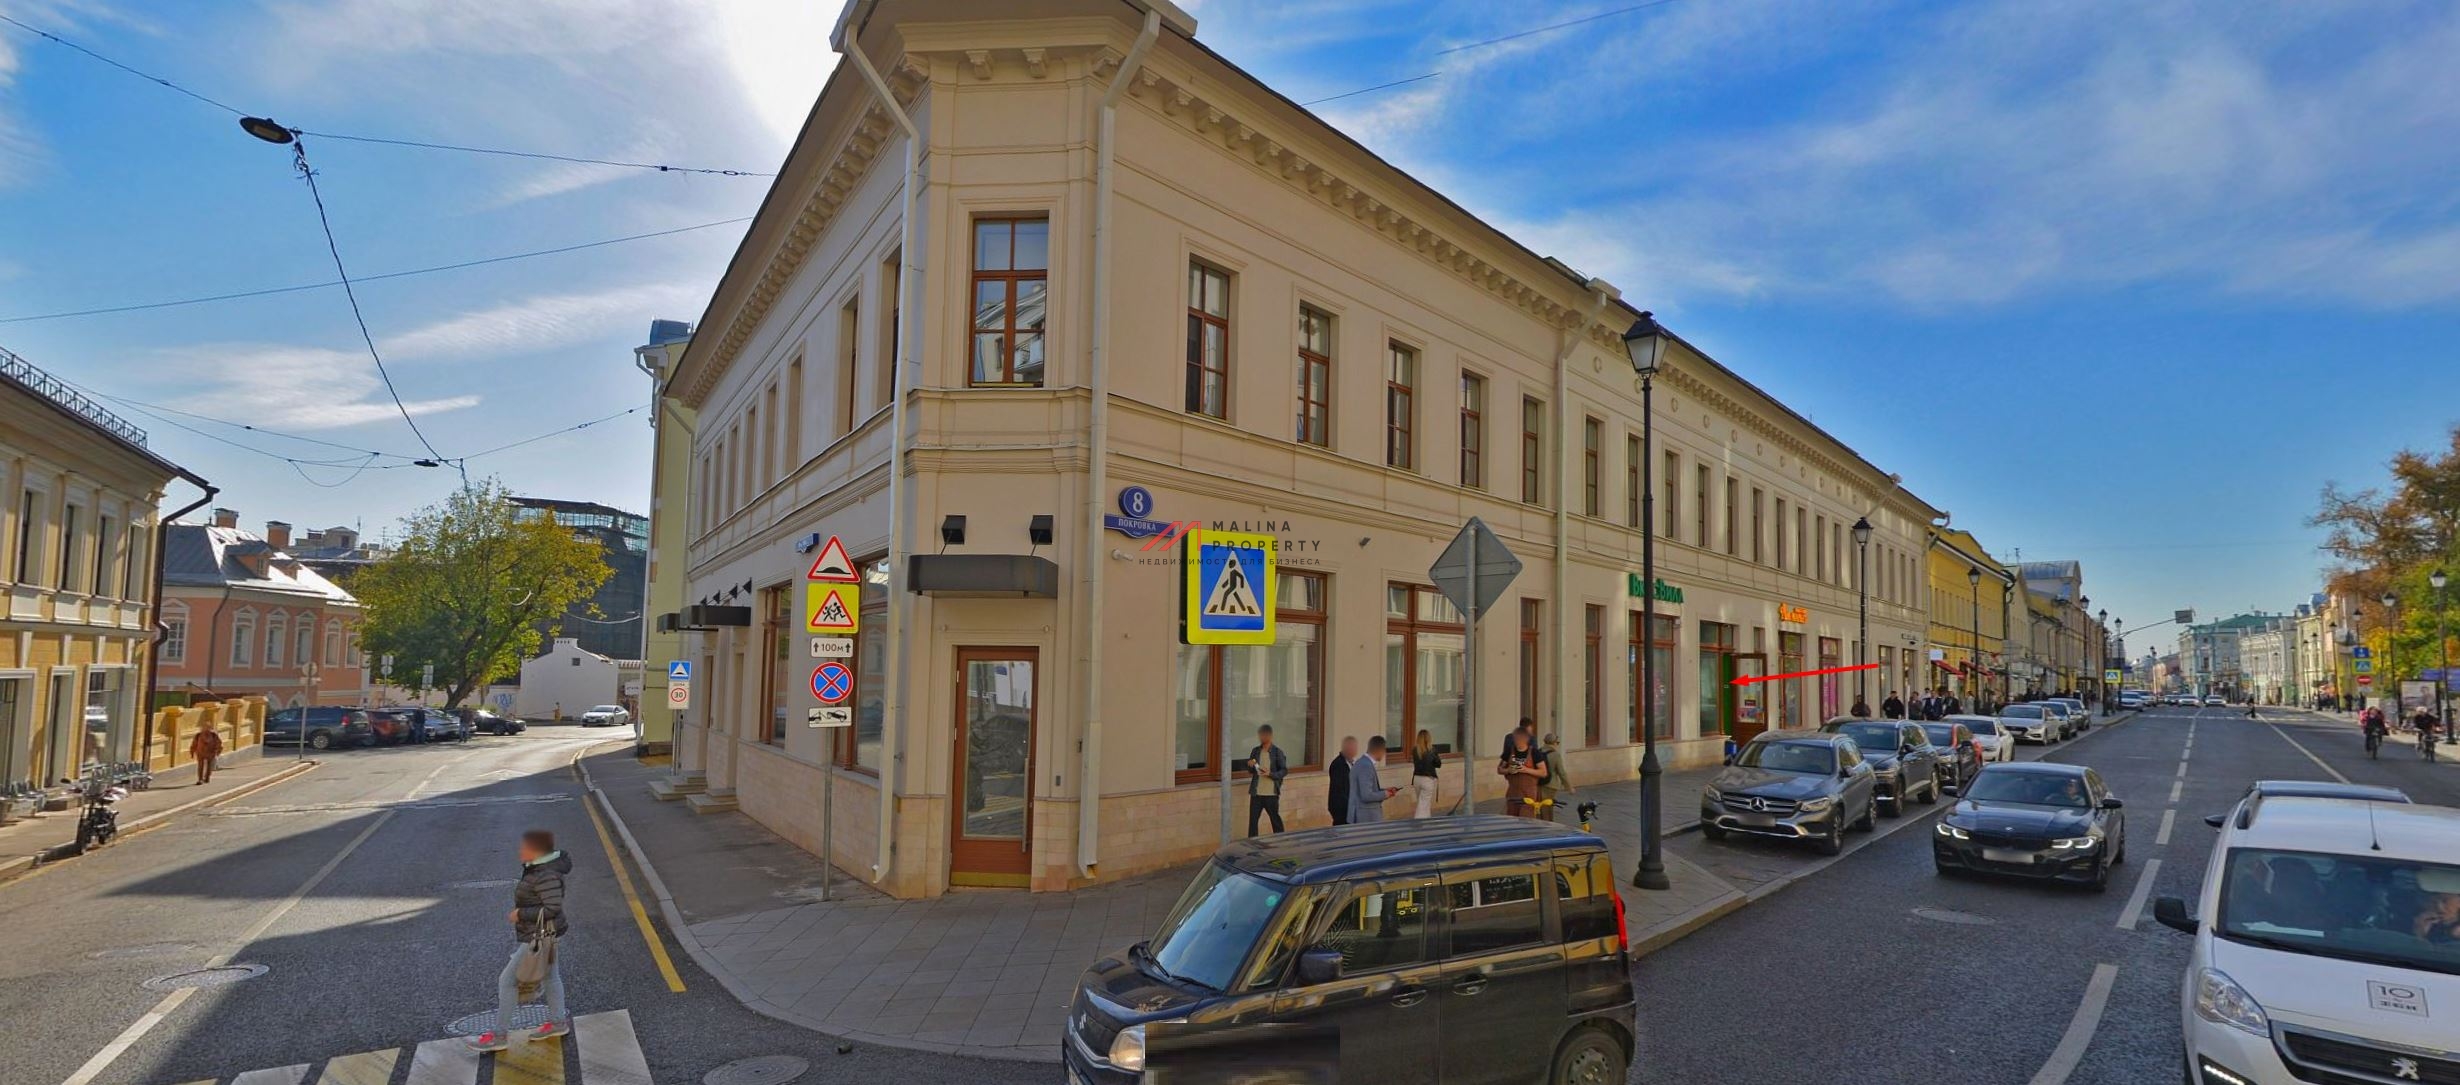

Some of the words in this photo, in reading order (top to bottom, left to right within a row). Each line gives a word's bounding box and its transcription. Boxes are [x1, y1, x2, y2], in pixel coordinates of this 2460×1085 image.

[1132, 491, 1144, 513] 8
[1118, 518, 1156, 532] ПОКРОВКА
[821, 643, 844, 652] 100м
[674, 691, 684, 699] 30
[2377, 985, 2415, 999] 10
